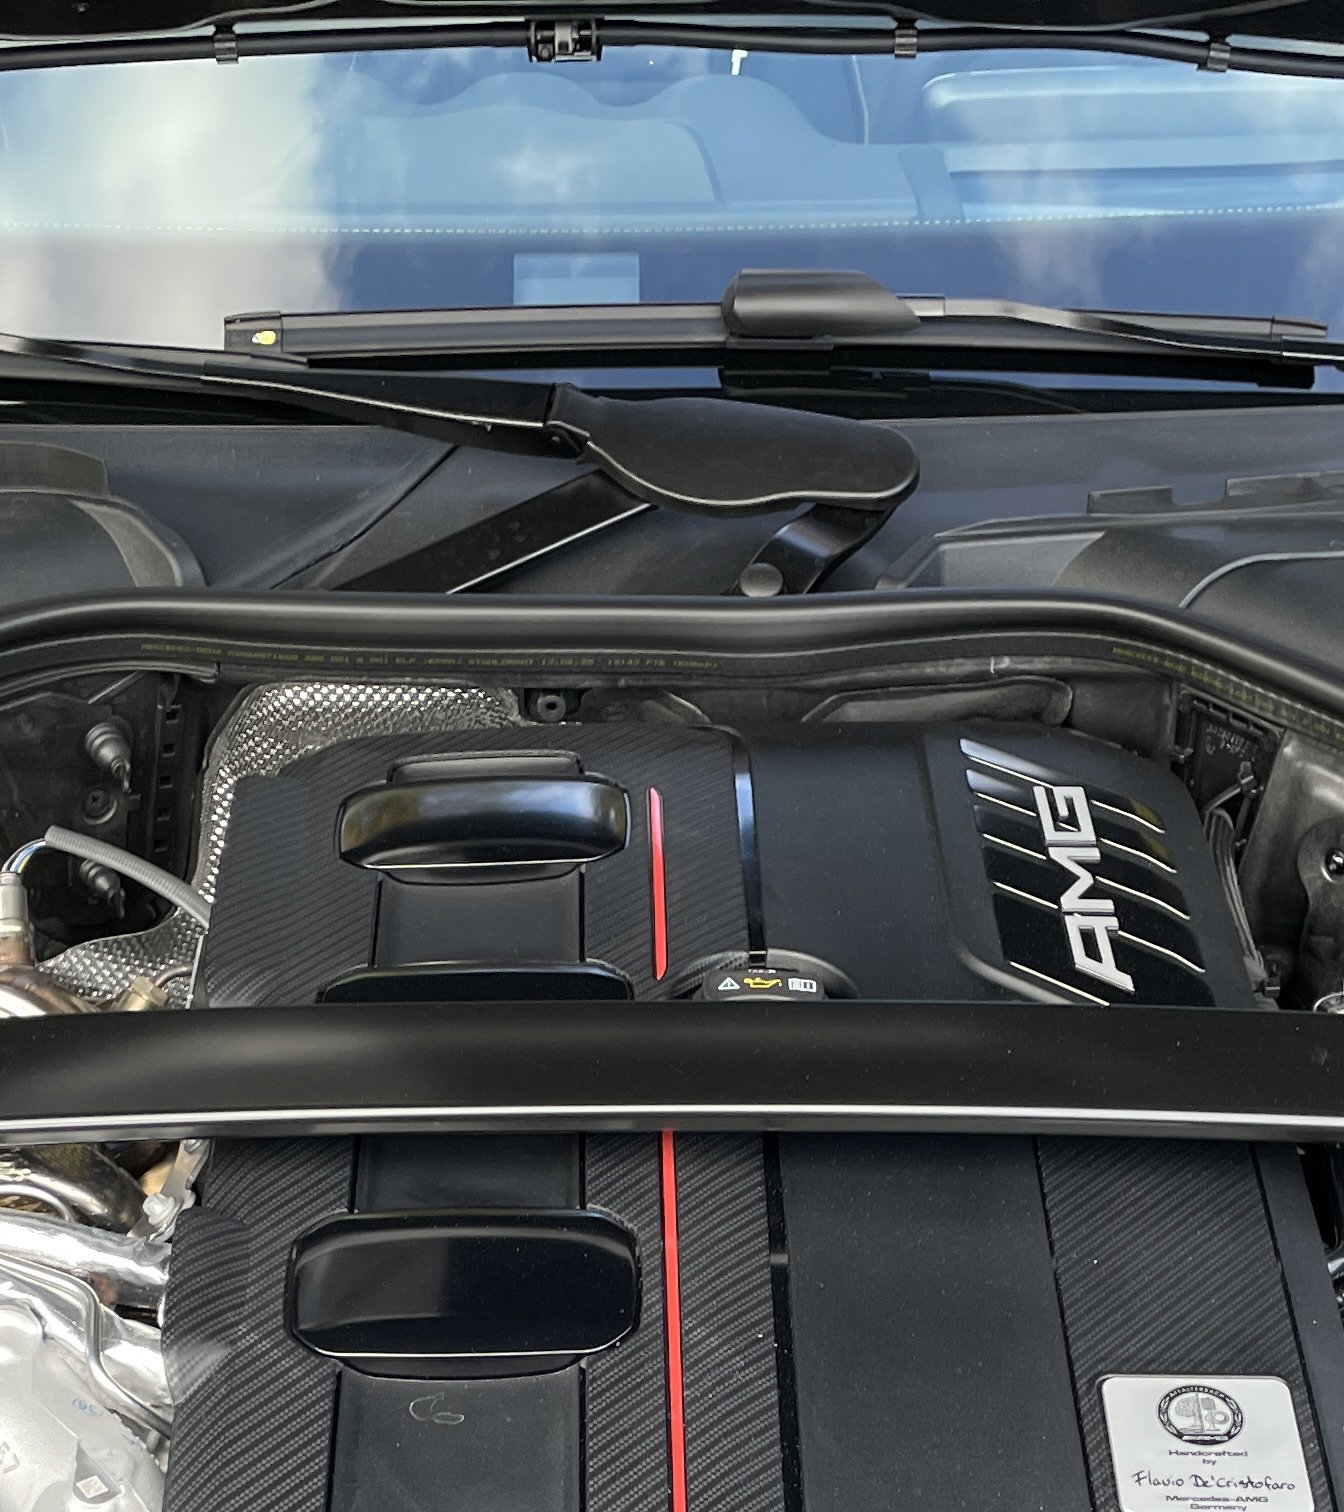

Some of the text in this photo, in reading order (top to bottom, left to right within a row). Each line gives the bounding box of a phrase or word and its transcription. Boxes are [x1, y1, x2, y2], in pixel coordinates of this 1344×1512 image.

[1033, 785, 1136, 994] AMG
[1168, 1449, 1249, 1458] Handcrafted
[1202, 1457, 1217, 1466] by
[1131, 1469, 1185, 1488] Flavio
[1165, 1495, 1269, 1503] Mercedes-AMG
[1190, 1503, 1248, 1512] Germany
